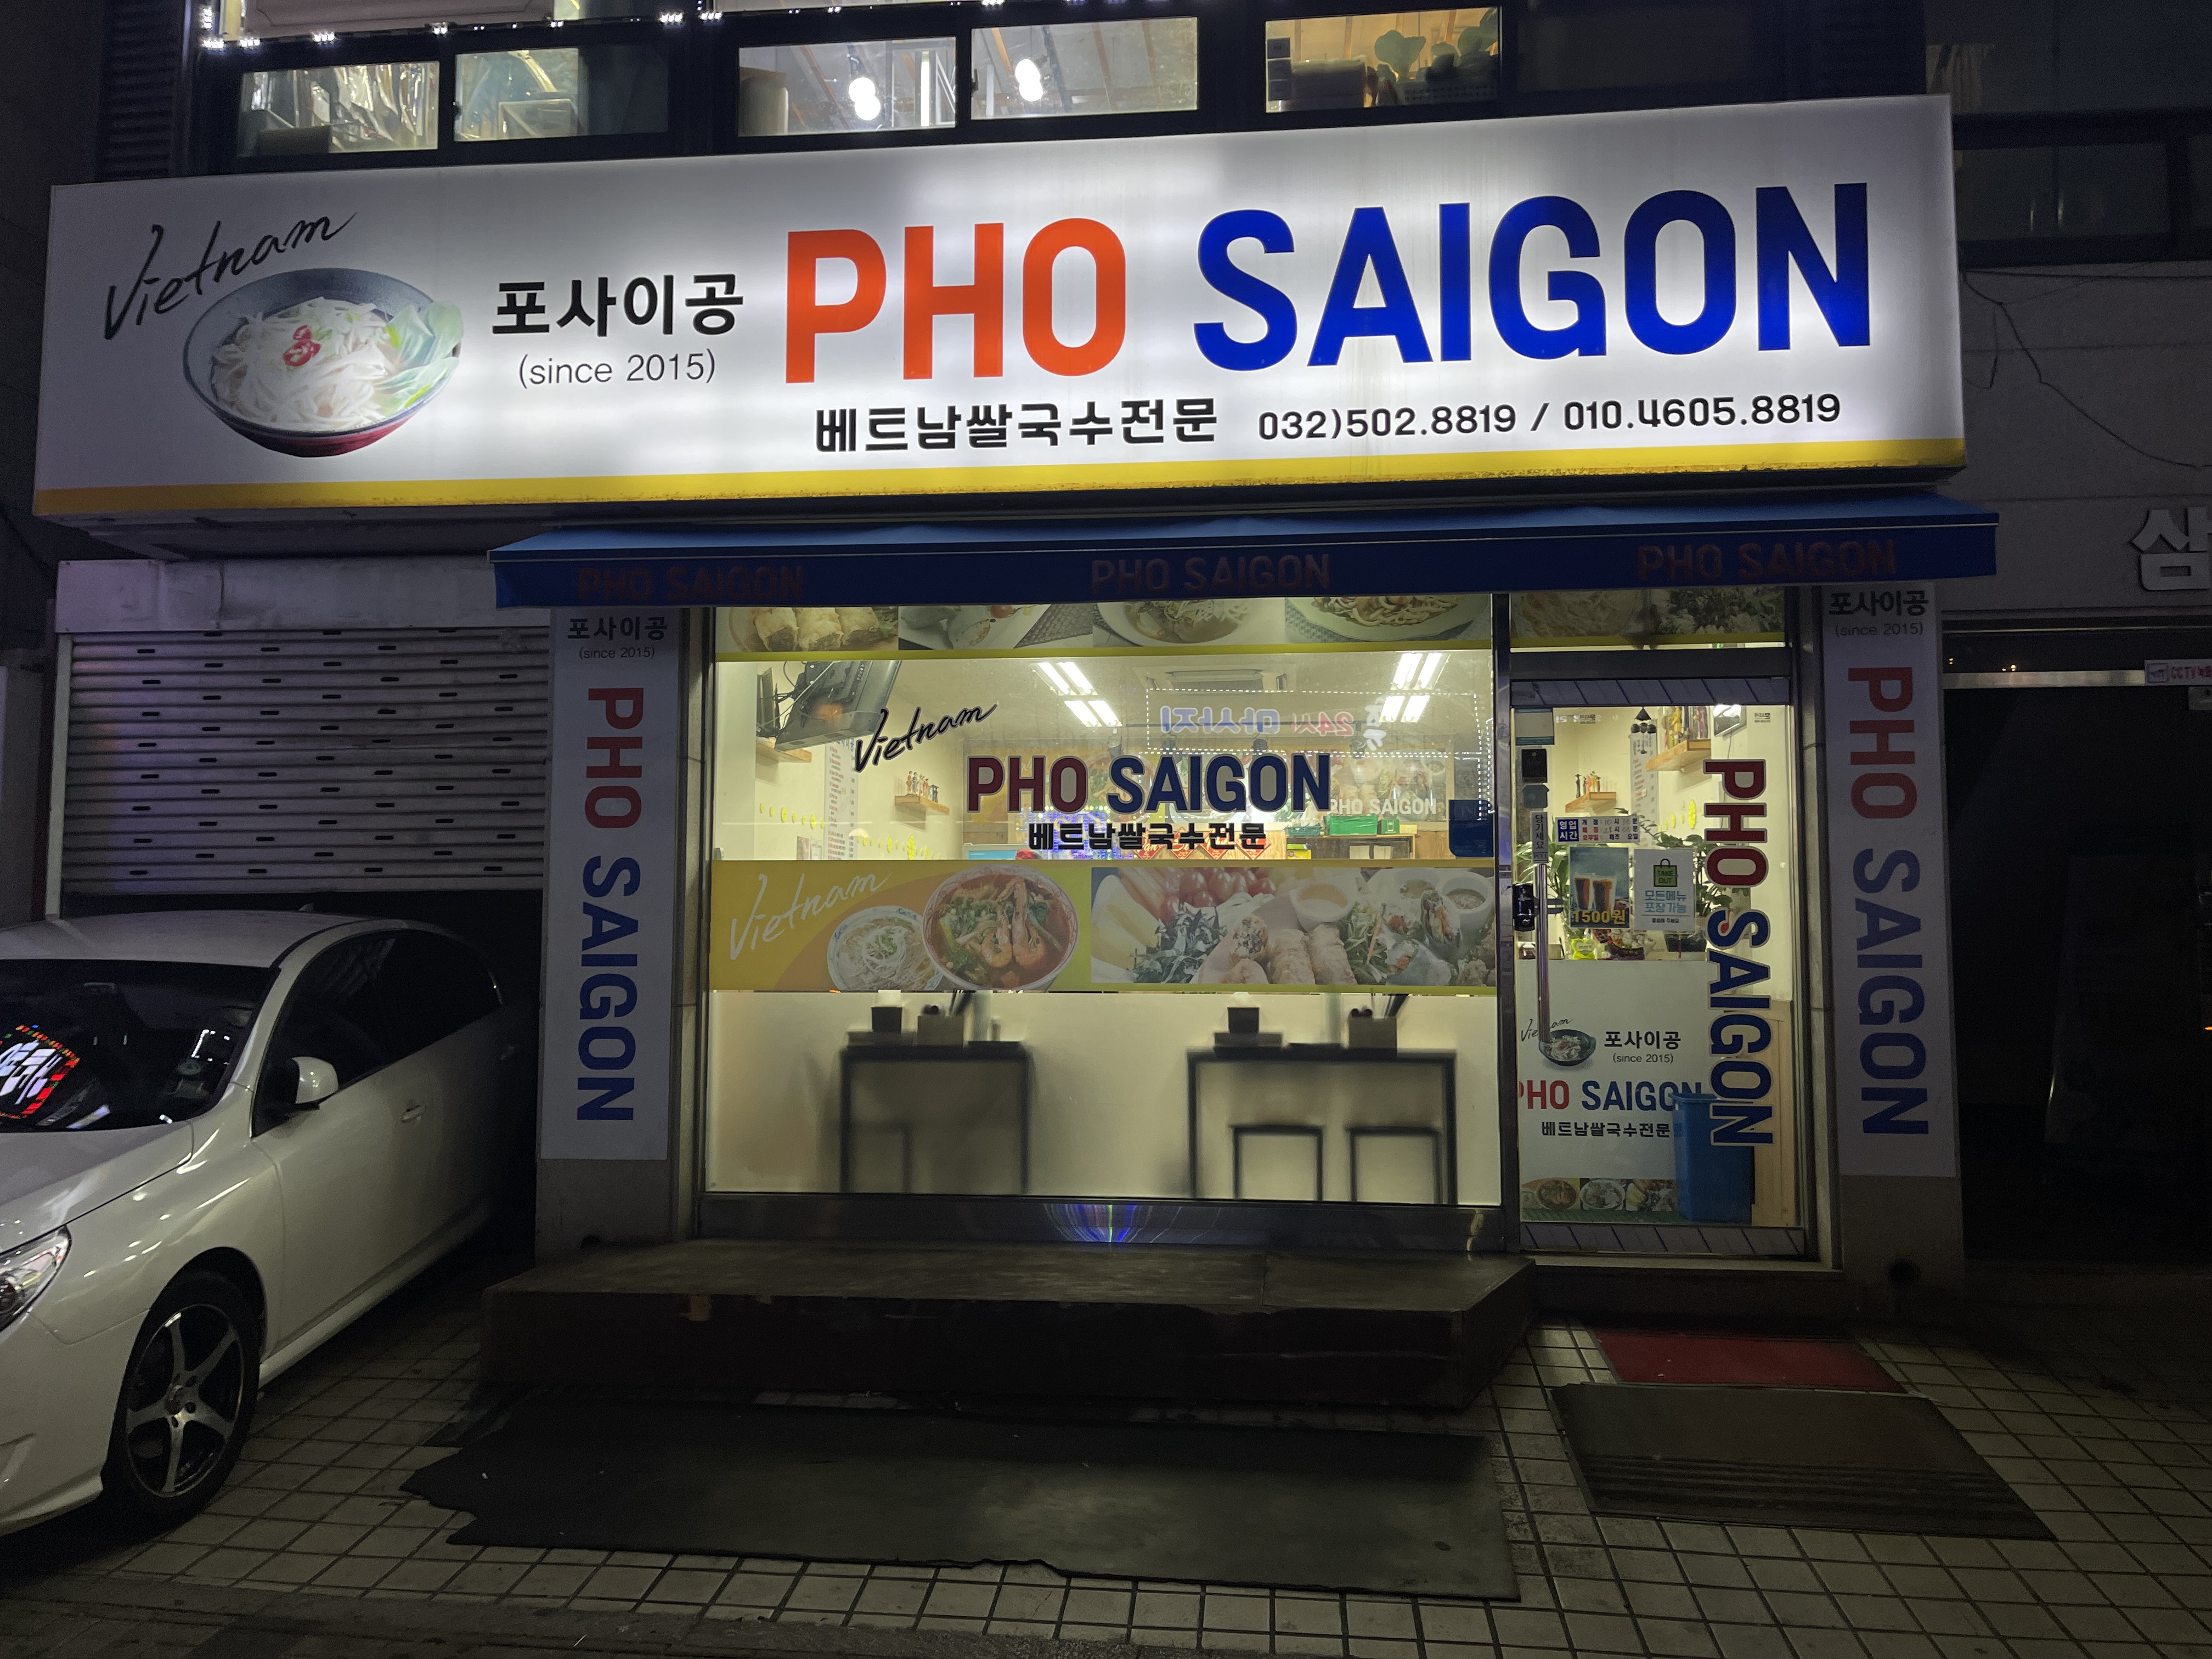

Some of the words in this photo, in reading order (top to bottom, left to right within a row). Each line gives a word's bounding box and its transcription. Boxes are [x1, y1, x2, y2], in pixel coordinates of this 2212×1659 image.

[103, 212, 358, 340] Vietnam
[786, 218, 1126, 383] PHO
[1193, 183, 1871, 371] SAIGON
[493, 273, 744, 337] 포사이공
[518, 353, 612, 388] (since
[626, 348, 716, 384] 2015)
[816, 398, 1217, 452] 베트남쌀국수전문
[1259, 404, 1516, 440] 032)502.8819
[1564, 393, 1840, 431] 010.4605.8819
[1091, 558, 1169, 595] PHO
[1184, 554, 1329, 593] SAIGON
[1638, 545, 1722, 582] PHO
[1737, 539, 1897, 580] SAIGON
[578, 567, 652, 601] PHO
[666, 566, 804, 601] SAIGON
[1829, 590, 1928, 616] 포사이공
[568, 617, 668, 641] 포사이공
[1835, 624, 1877, 636] (since
[1883, 622, 1923, 635] 2015)
[579, 647, 616, 660] (since
[620, 646, 654, 659] 2015)
[854, 703, 998, 774] Vietnam
[1848, 667, 1917, 819] PHO
[585, 688, 644, 828] PHO
[967, 755, 1088, 814] PHO
[1107, 752, 1331, 814] SAIGON
[1369, 798, 1437, 815] SAIGON
[1703, 759, 1769, 888] PHO
[1028, 822, 1266, 850] 베트남쌀국수전문
[1536, 814, 1544, 849] 당기세요
[1559, 821, 1577, 830] 영업
[1559, 831, 1577, 840] 시간
[1644, 890, 1687, 901] 모든메뉴
[1644, 902, 1687, 913] 포장가능
[730, 872, 892, 961] Vietnam
[1573, 910, 1626, 925] 1500원
[577, 856, 641, 1120] SAIGON
[1853, 848, 1929, 1135] SAIGON
[1521, 1018, 1573, 1041] Vieam
[1604, 1030, 1681, 1049] 포사이공
[1706, 909, 1774, 1147] SAIGON
[1612, 1053, 1643, 1064] (since
[1645, 1053, 1674, 1064] 2015)
[1541, 1121, 1671, 1138] 베트남쌀국수전문
